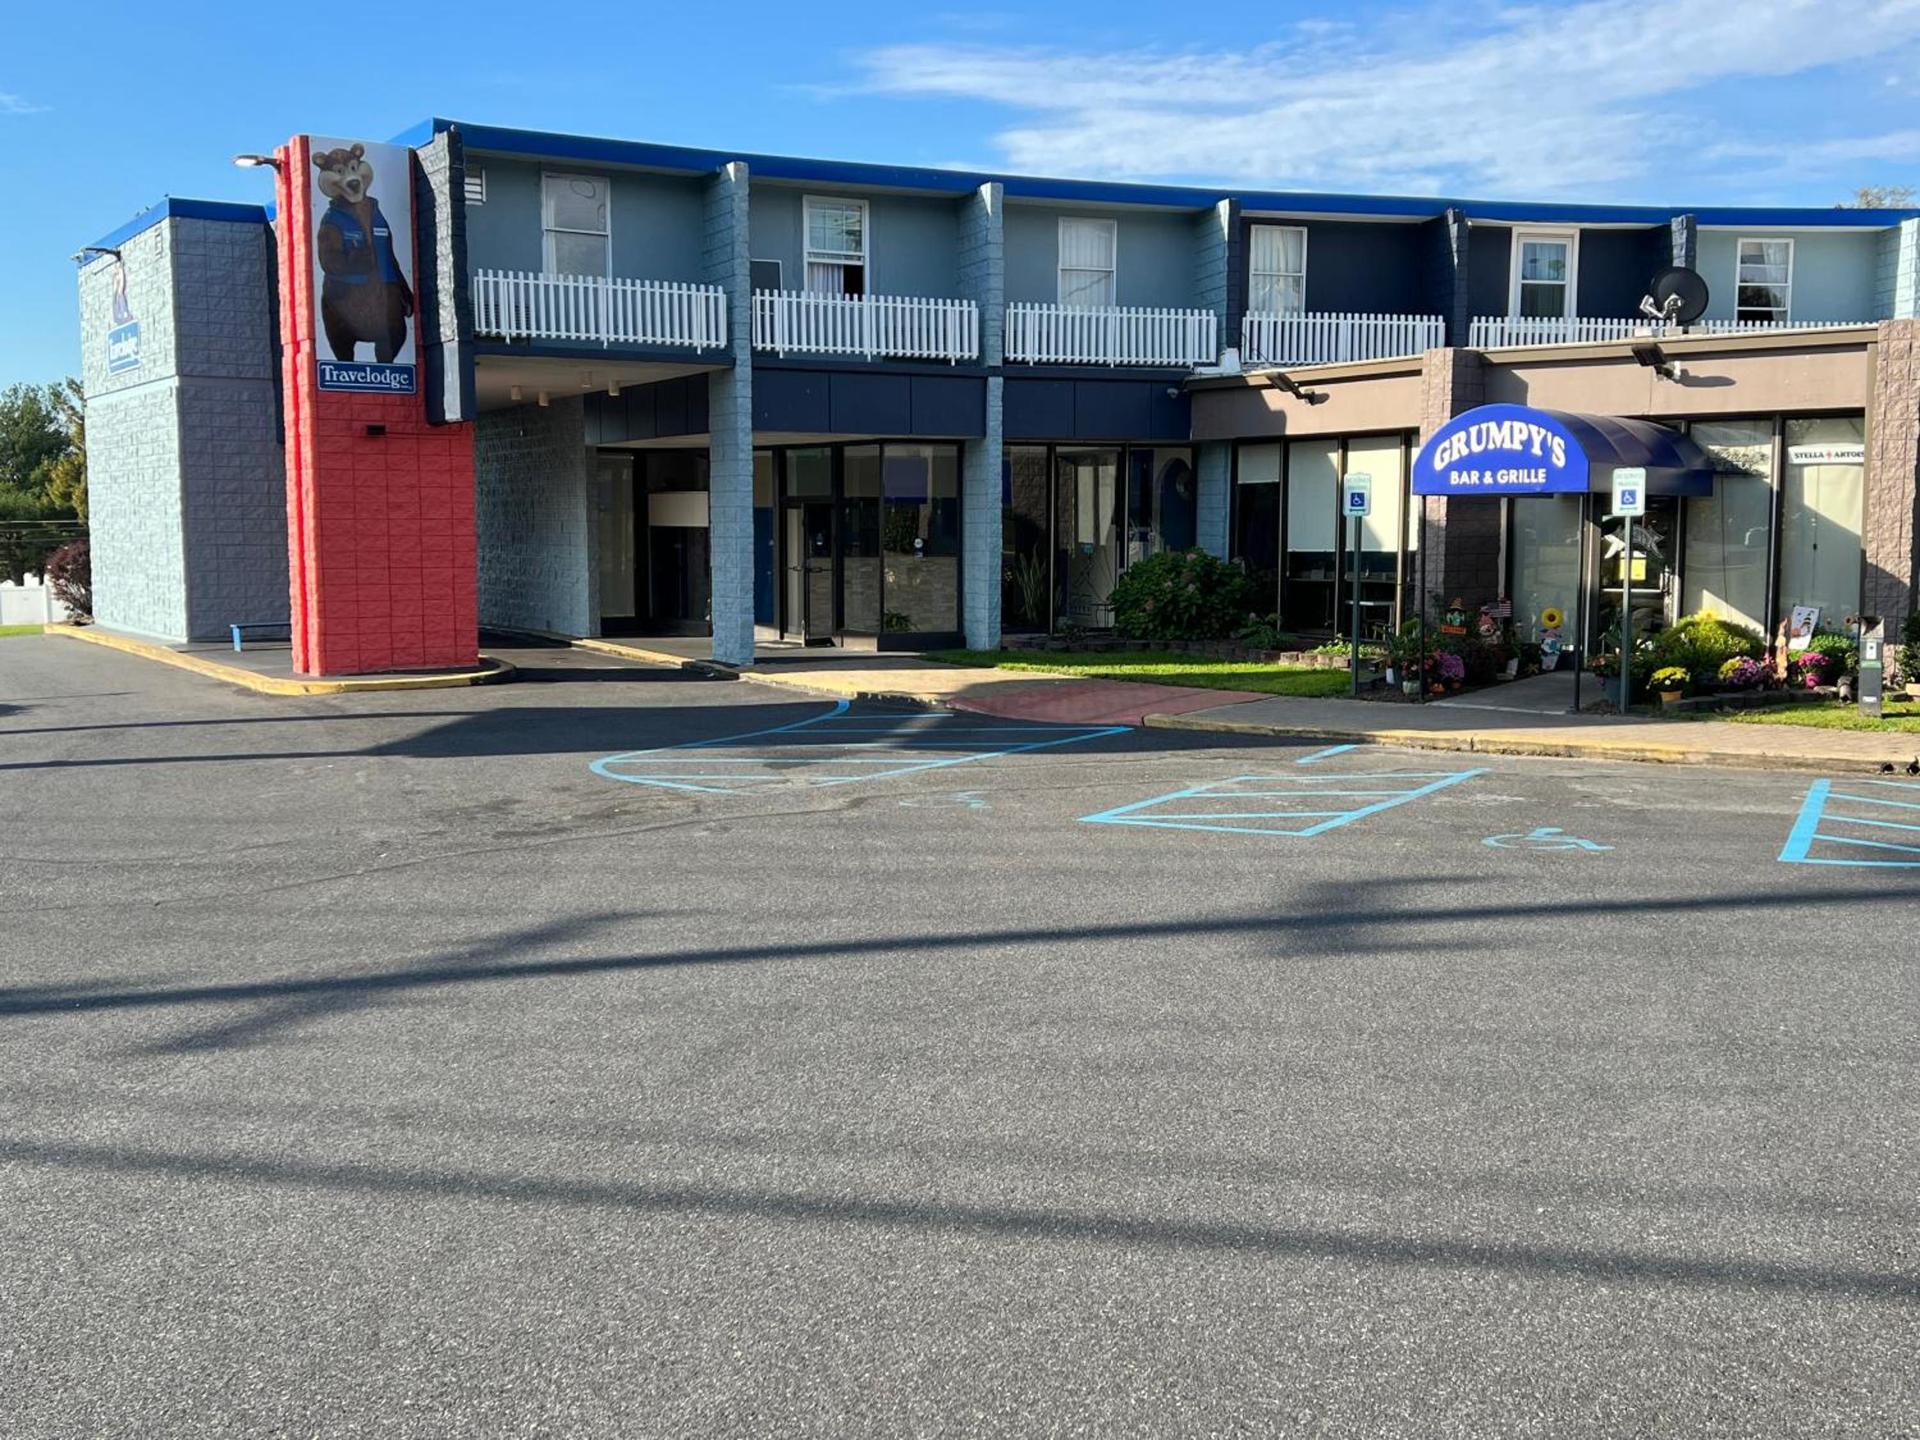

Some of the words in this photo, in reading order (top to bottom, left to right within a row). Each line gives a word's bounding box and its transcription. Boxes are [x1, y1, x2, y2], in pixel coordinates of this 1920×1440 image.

[320, 365, 409, 388] Travelodge
[1433, 420, 1566, 471] GRUMPY'S
[1794, 451, 1825, 459] STELLA
[1450, 470, 1480, 485] BAR
[1483, 471, 1494, 485] &
[1497, 468, 1547, 484] GRILLE
